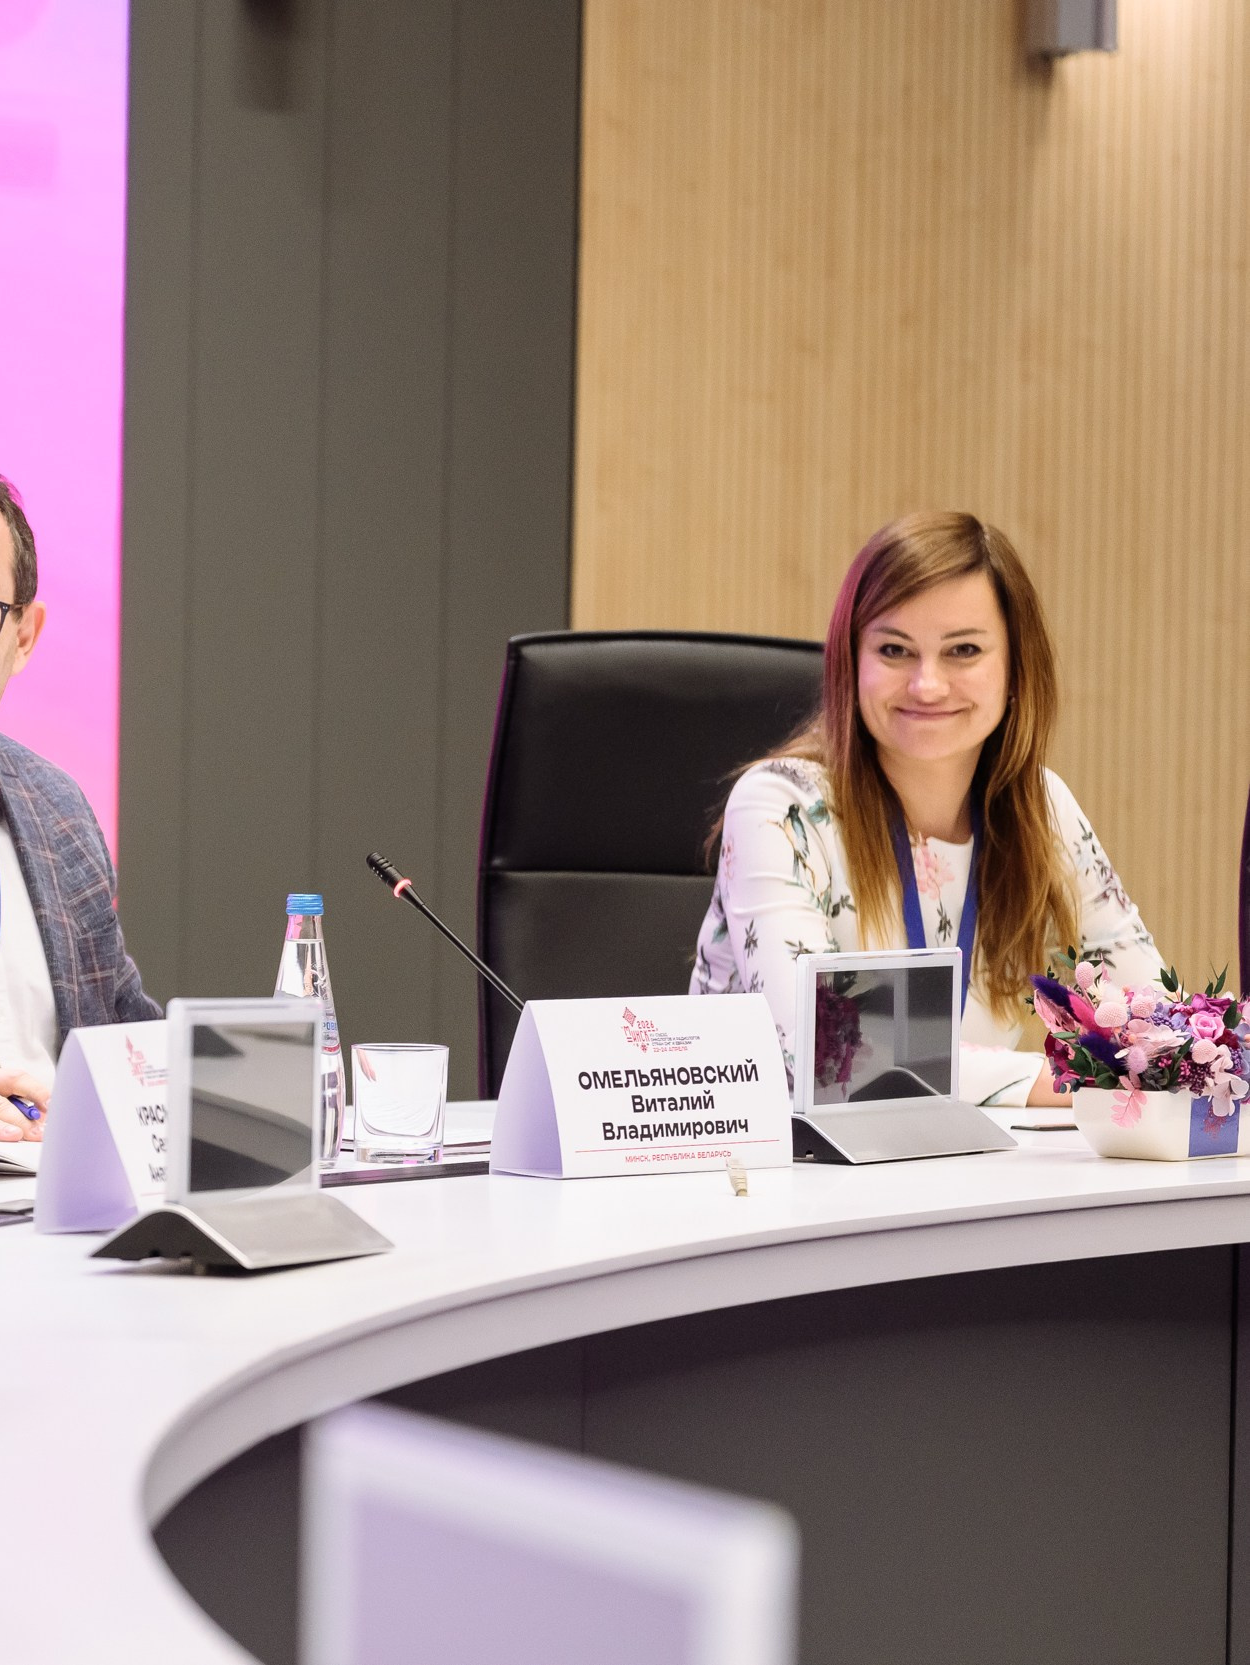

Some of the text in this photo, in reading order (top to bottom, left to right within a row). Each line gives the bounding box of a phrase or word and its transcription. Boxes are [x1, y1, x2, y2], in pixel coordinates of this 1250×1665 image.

[578, 1059, 759, 1091] ОМЕЛЬЯНОВСКИЙ
[631, 1090, 715, 1114] Виталий
[602, 1117, 749, 1142] Владимирович
[625, 1150, 732, 1164] МИНСК, РЕСПУБЛИКА БЕЛАРУСЬ
